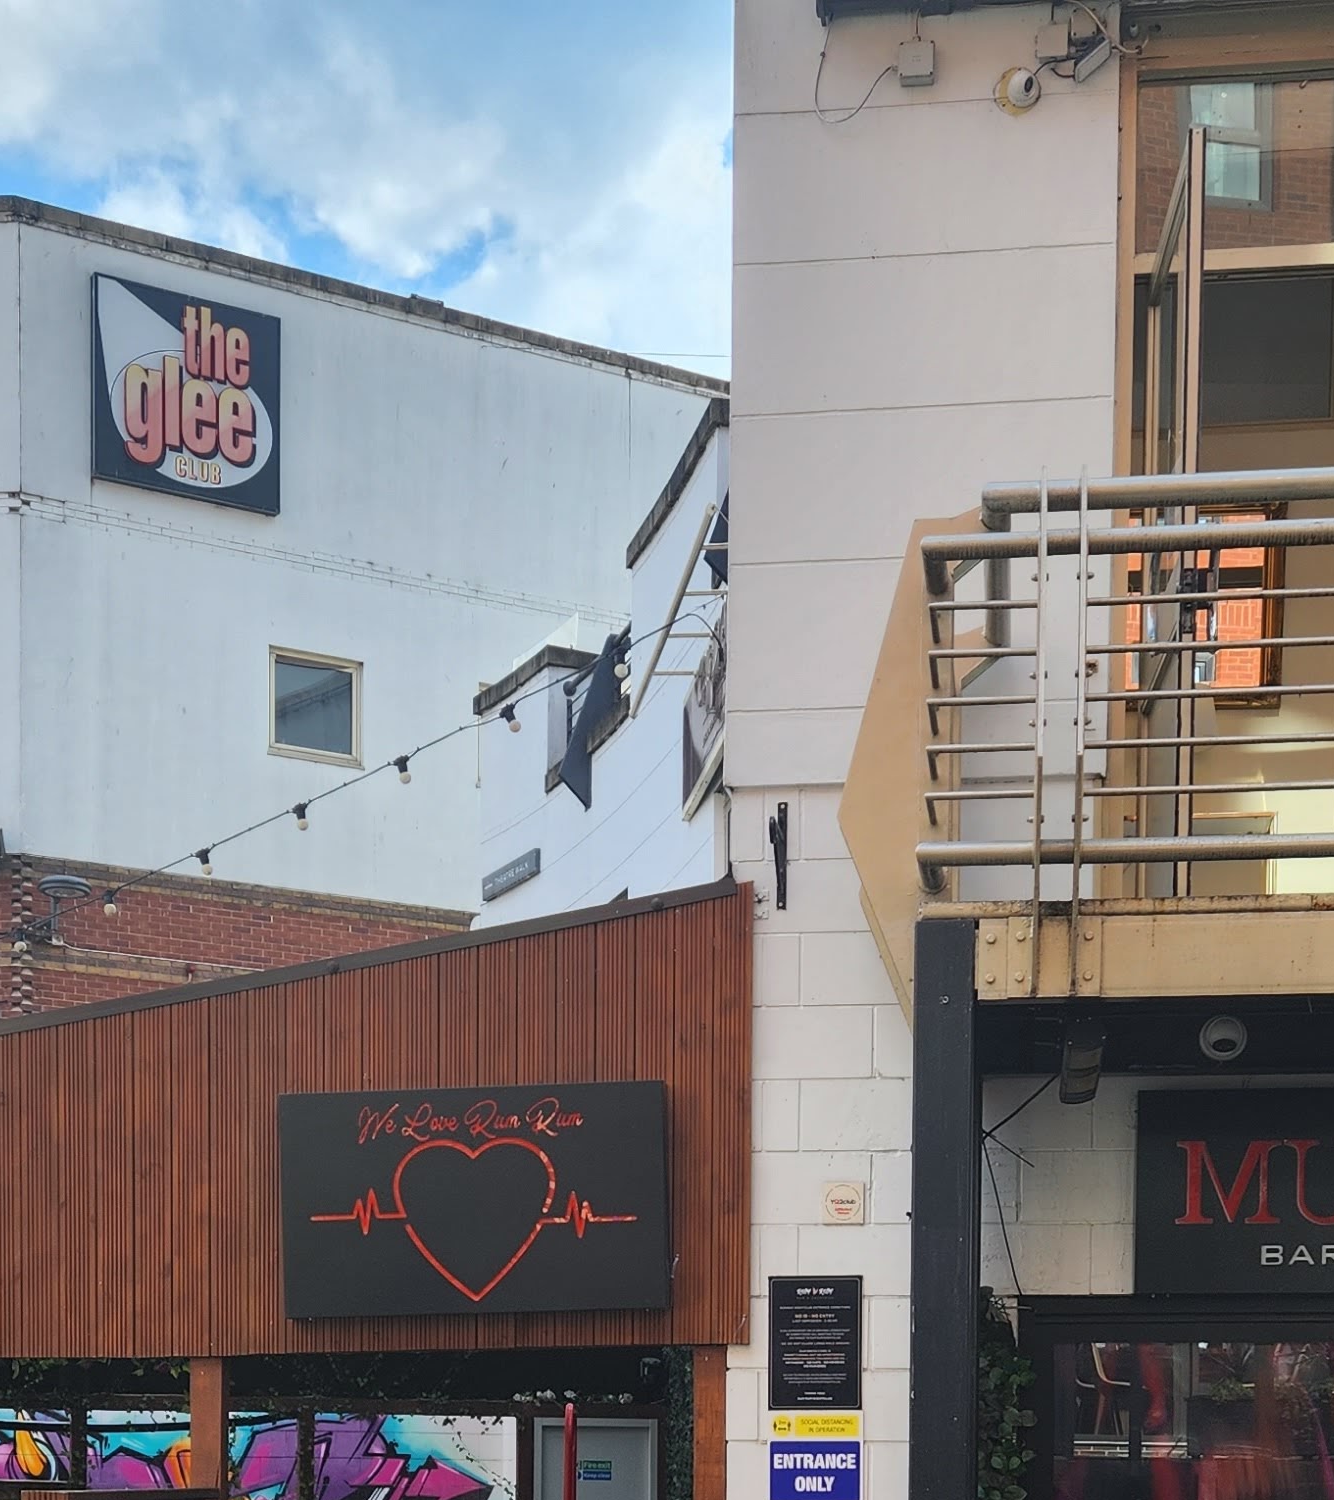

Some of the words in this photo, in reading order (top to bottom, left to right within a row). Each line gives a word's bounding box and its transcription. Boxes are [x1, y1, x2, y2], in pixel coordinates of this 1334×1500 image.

[182, 305, 250, 389] the
[124, 355, 256, 468] glee
[175, 455, 221, 484] CLUB
[359, 1103, 399, 1144] We
[402, 1102, 459, 1141] Love
[464, 1099, 521, 1139] Rum
[526, 1097, 583, 1137] Rum
[773, 1453, 857, 1469] ENTRANCE
[794, 1475, 835, 1492] ONLY
